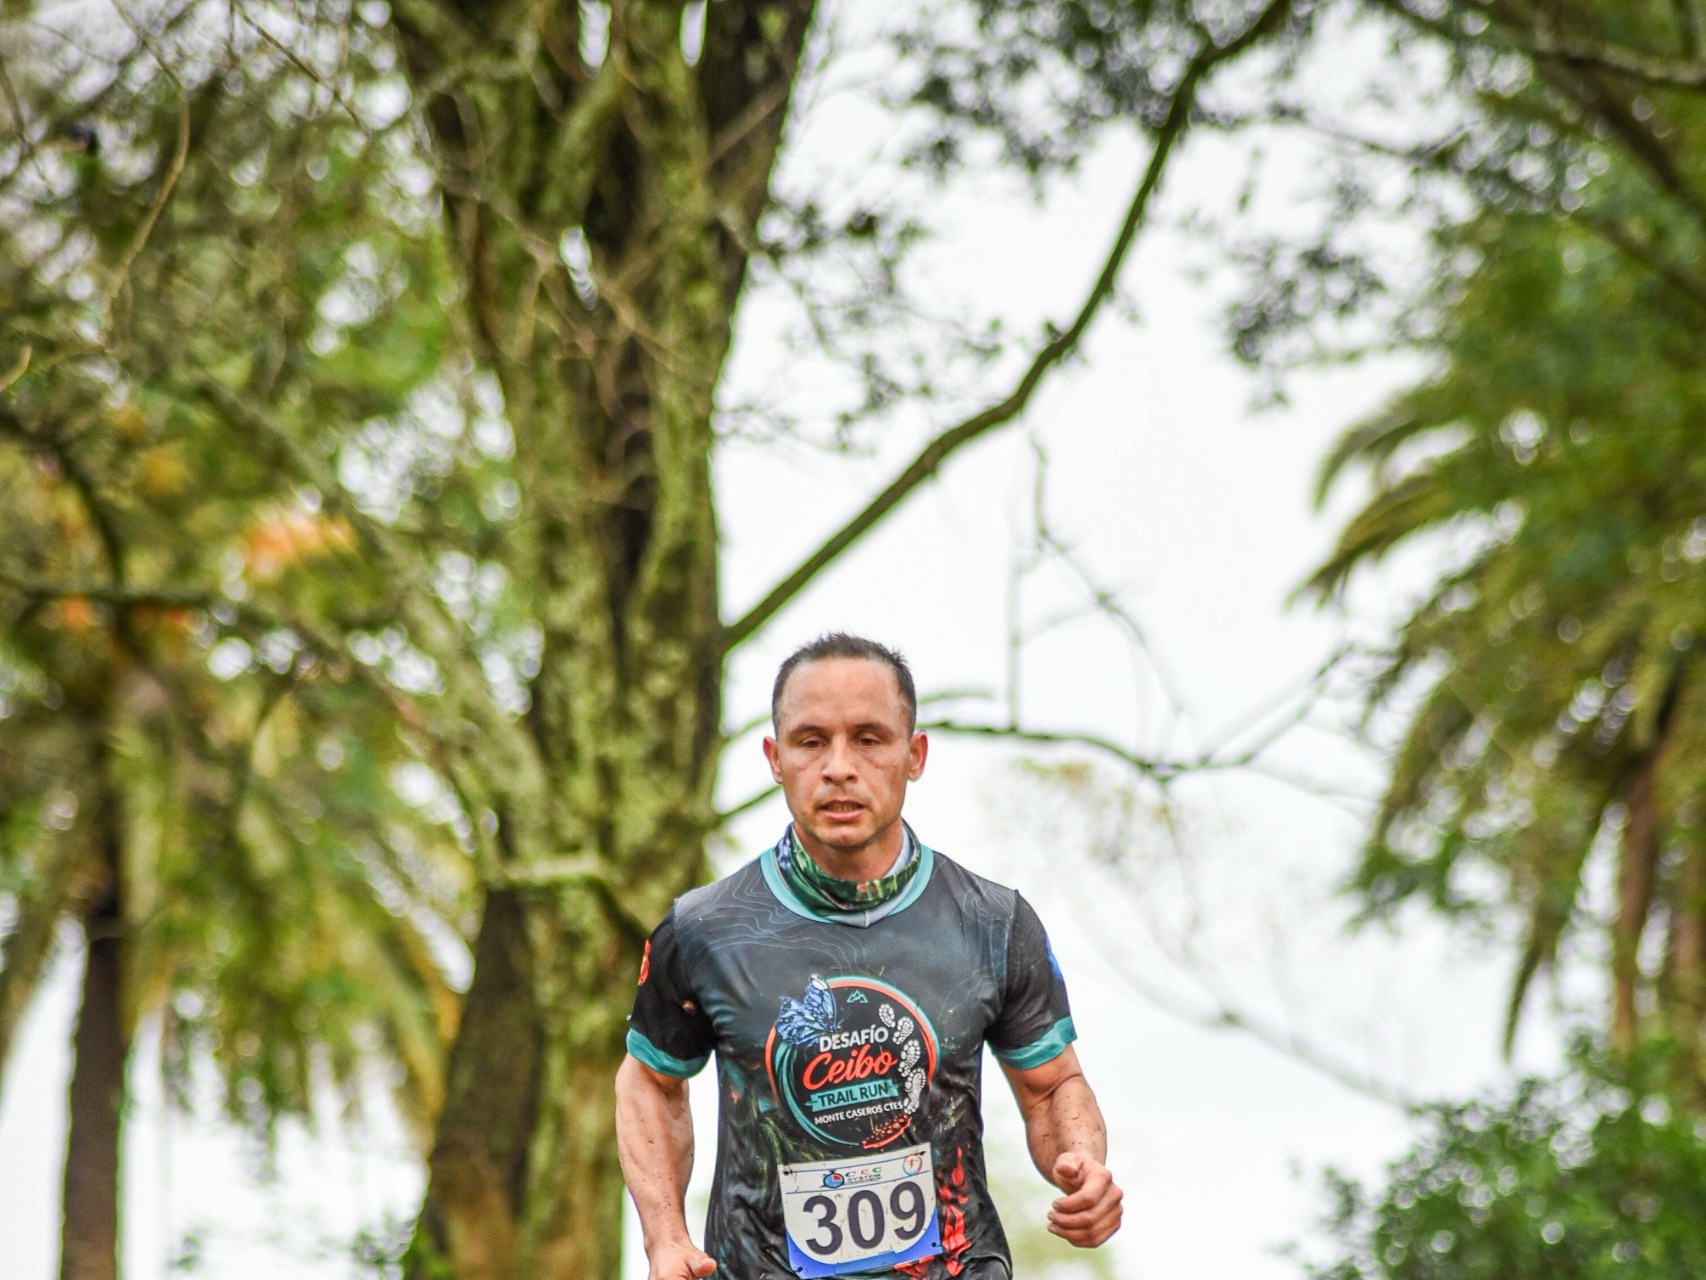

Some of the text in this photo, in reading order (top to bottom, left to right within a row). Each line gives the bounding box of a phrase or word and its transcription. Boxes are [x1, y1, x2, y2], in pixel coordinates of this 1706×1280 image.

[819, 1025, 889, 1052] DESAFÍO
[803, 1044, 898, 1090] Ceibo
[818, 1083, 889, 1107] TRAIL RUN
[814, 1101, 903, 1126] MONTE CASEROS CTES
[802, 1181, 926, 1256] 309
